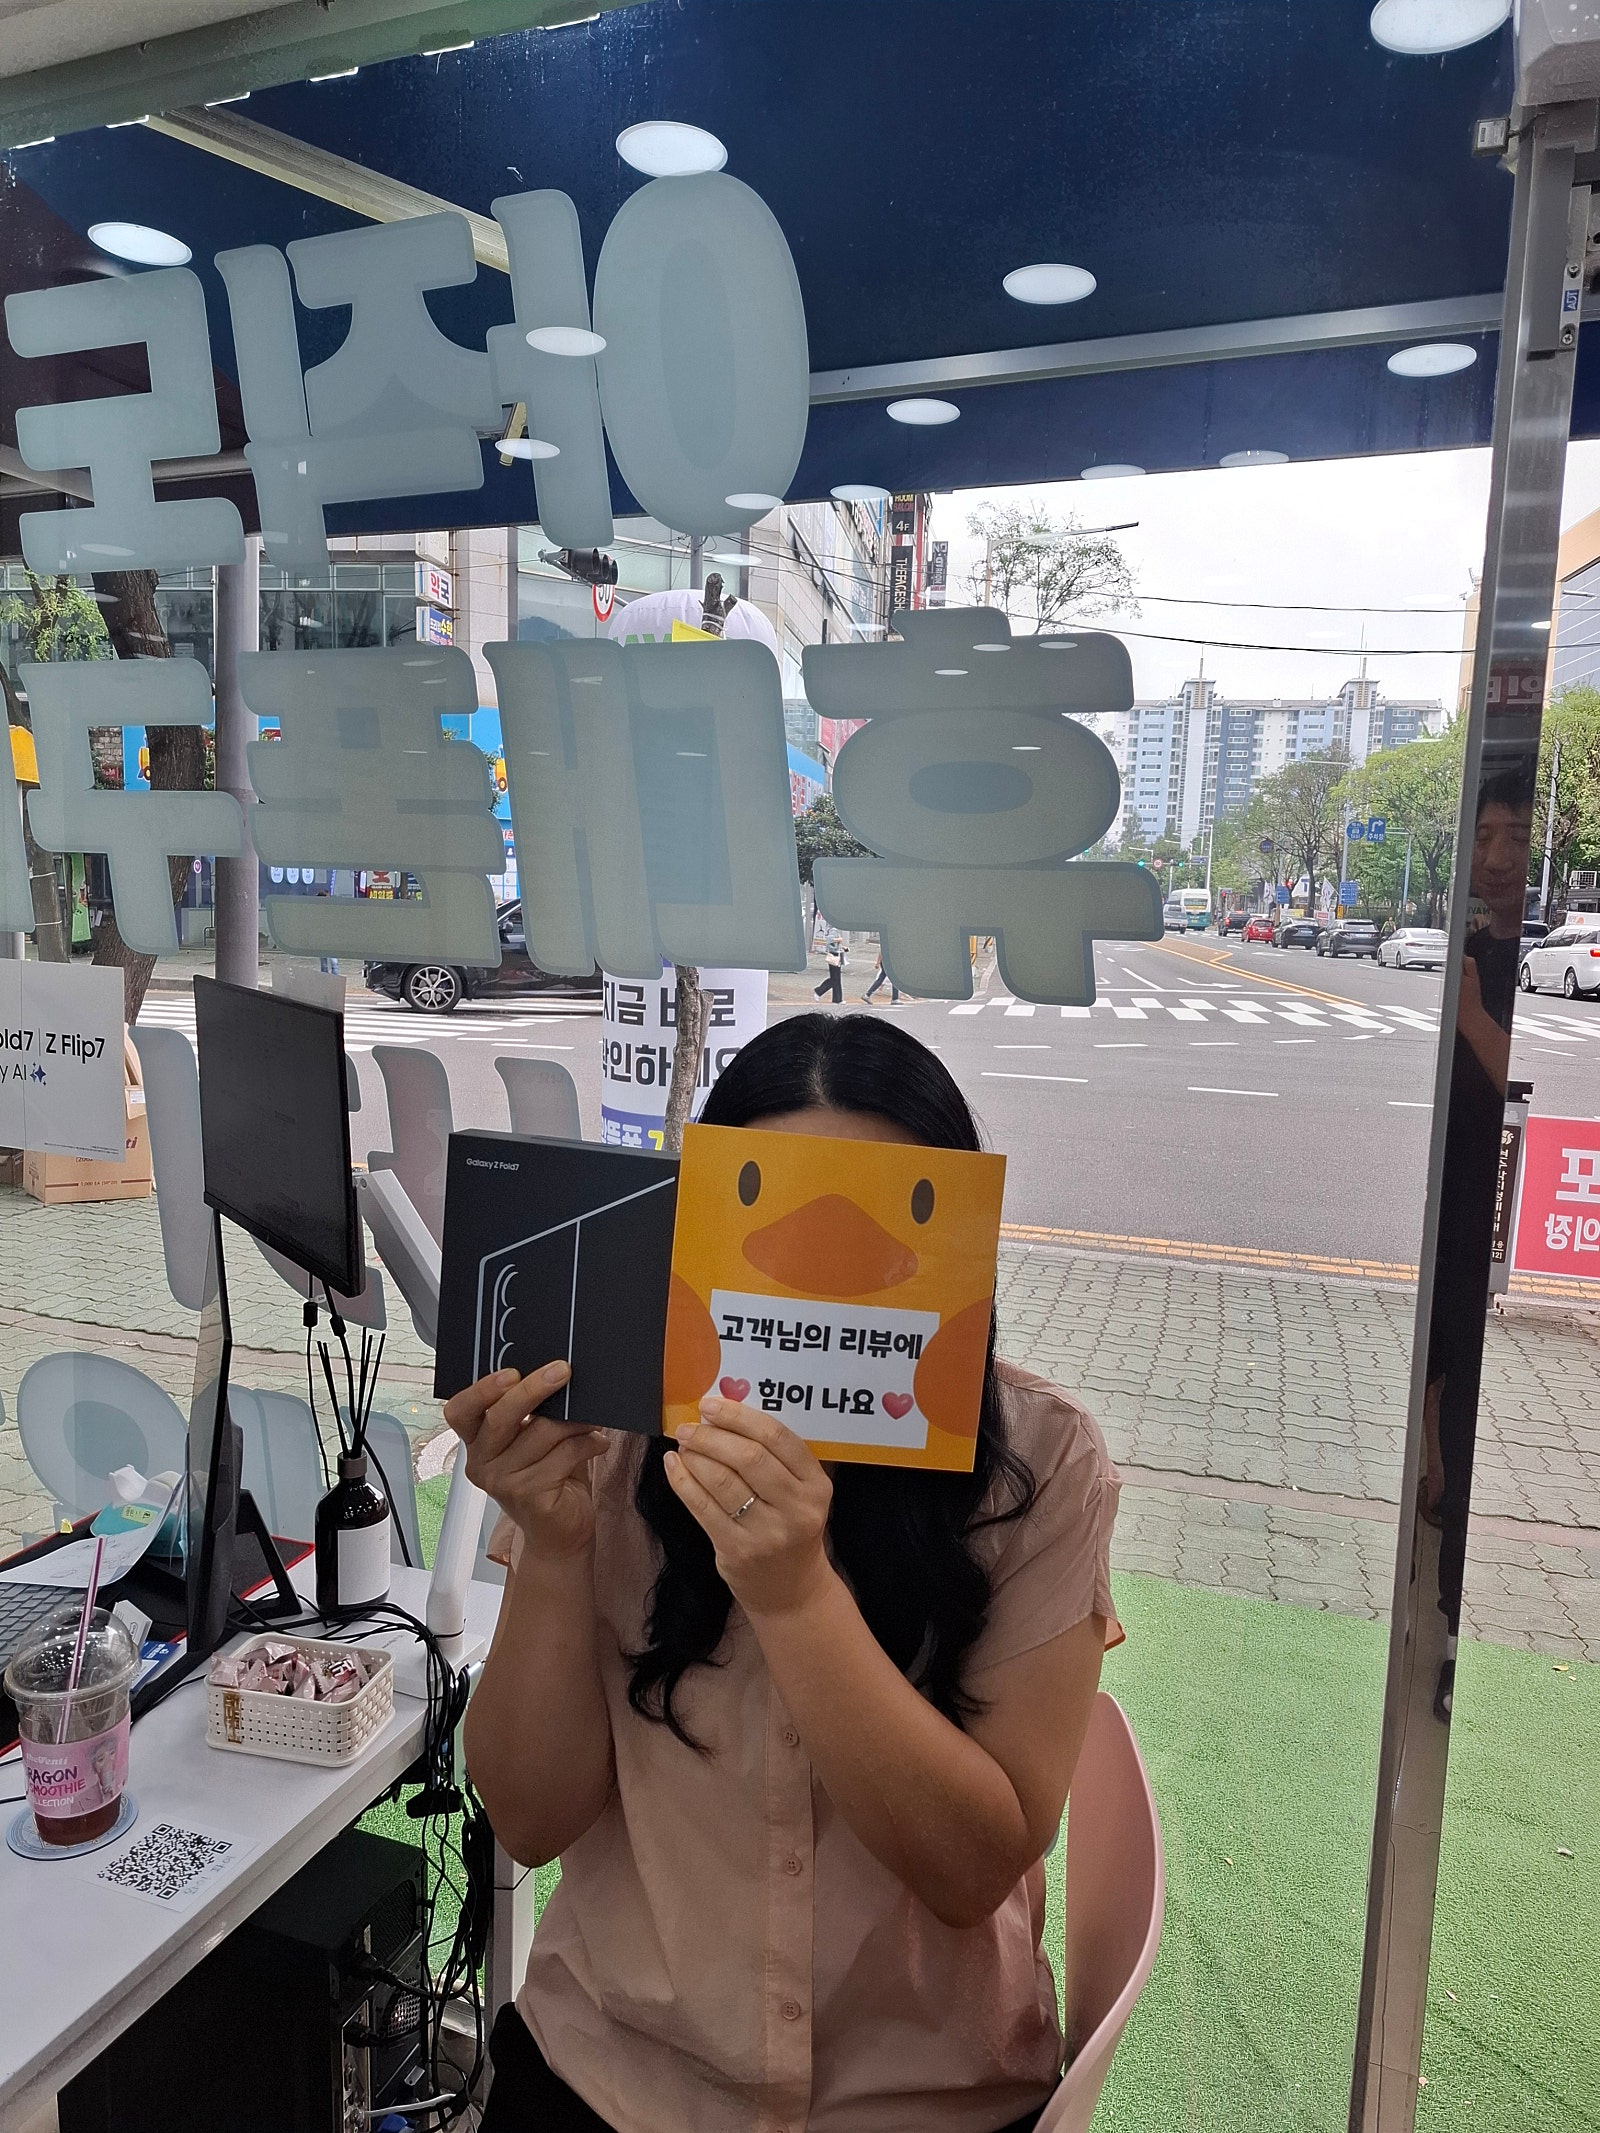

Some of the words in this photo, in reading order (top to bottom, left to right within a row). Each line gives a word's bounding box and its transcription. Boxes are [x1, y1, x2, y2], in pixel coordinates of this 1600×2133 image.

[430, 572, 450, 605] 약국
[45, 1032, 57, 1054] Z
[61, 1033, 105, 1065] Flip7
[12, 1063, 27, 1081] AI
[466, 1157, 494, 1170] Galaxy
[493, 1160, 499, 1169] Z
[499, 1161, 520, 1171] Fold7
[718, 1313, 831, 1353] 고객님의
[839, 1326, 924, 1360] 리뷰에
[758, 1377, 814, 1412] 힘이
[821, 1387, 875, 1415] 나요
